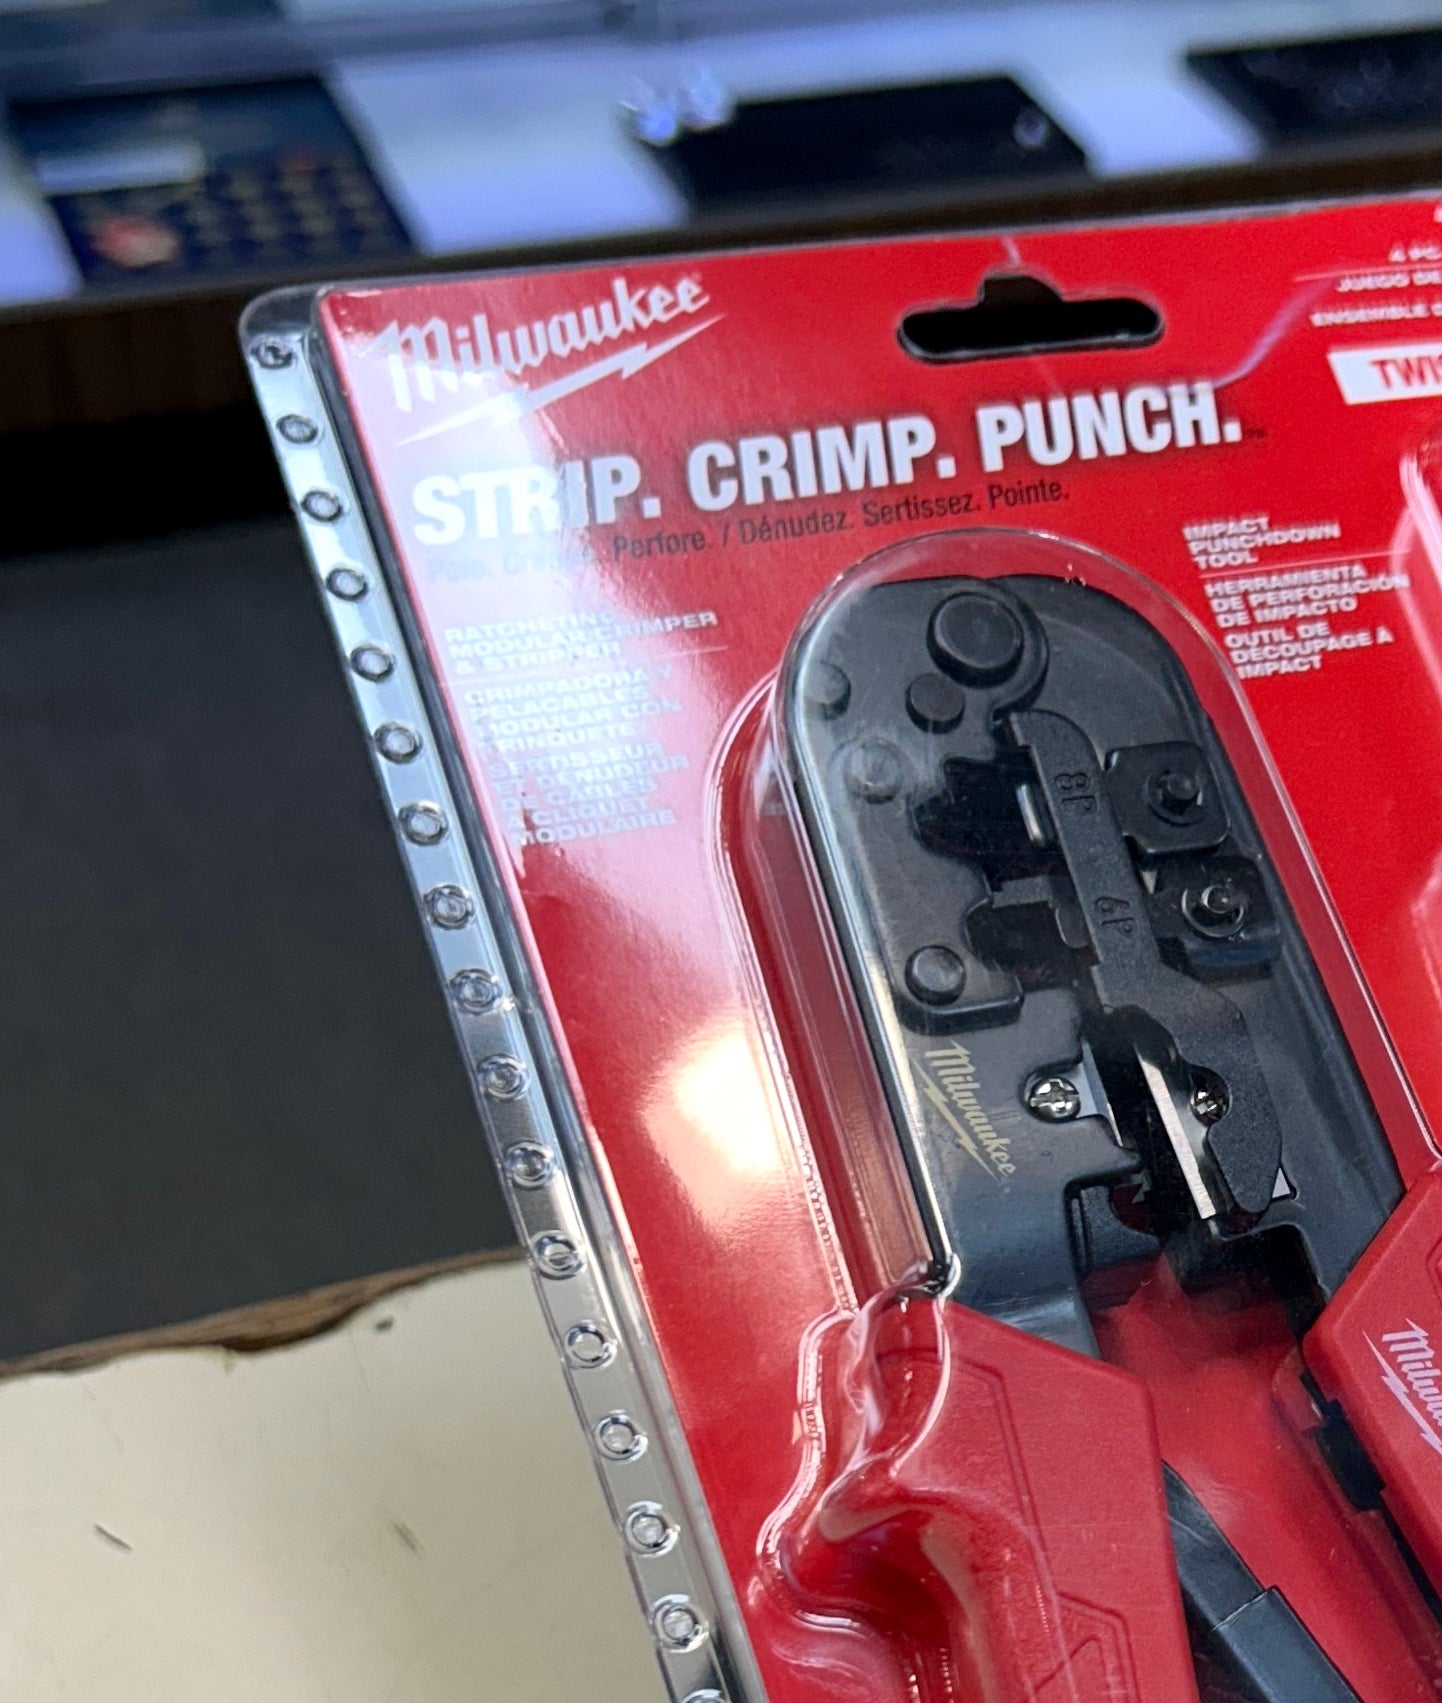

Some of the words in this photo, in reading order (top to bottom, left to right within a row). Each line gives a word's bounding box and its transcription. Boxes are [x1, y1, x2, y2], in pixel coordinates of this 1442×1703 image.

[1413, 268, 1442, 285] DE
[356, 276, 711, 412] Milwaukee
[411, 455, 661, 546] STRIP.
[687, 415, 957, 512] CRIMP.
[976, 380, 1242, 474] PUNCH.
[862, 487, 981, 528] Sertissez.
[987, 478, 1071, 511] Pointe.
[1183, 516, 1269, 541] IMPACT
[1189, 524, 1341, 554] PUNCHDOWN
[1194, 550, 1258, 569] TOOL
[1205, 565, 1366, 596] HERRAMIENTA
[1210, 596, 1244, 613] DE
[1248, 573, 1410, 605] PERFORACIÓN
[1216, 611, 1250, 628] DE
[1253, 597, 1358, 623] IMPACTO
[1224, 628, 1294, 649] OUTIL
[1297, 621, 1330, 639] DE
[1236, 655, 1322, 680] IMPACT
[924, 1039, 1017, 1177] Milwaukee
